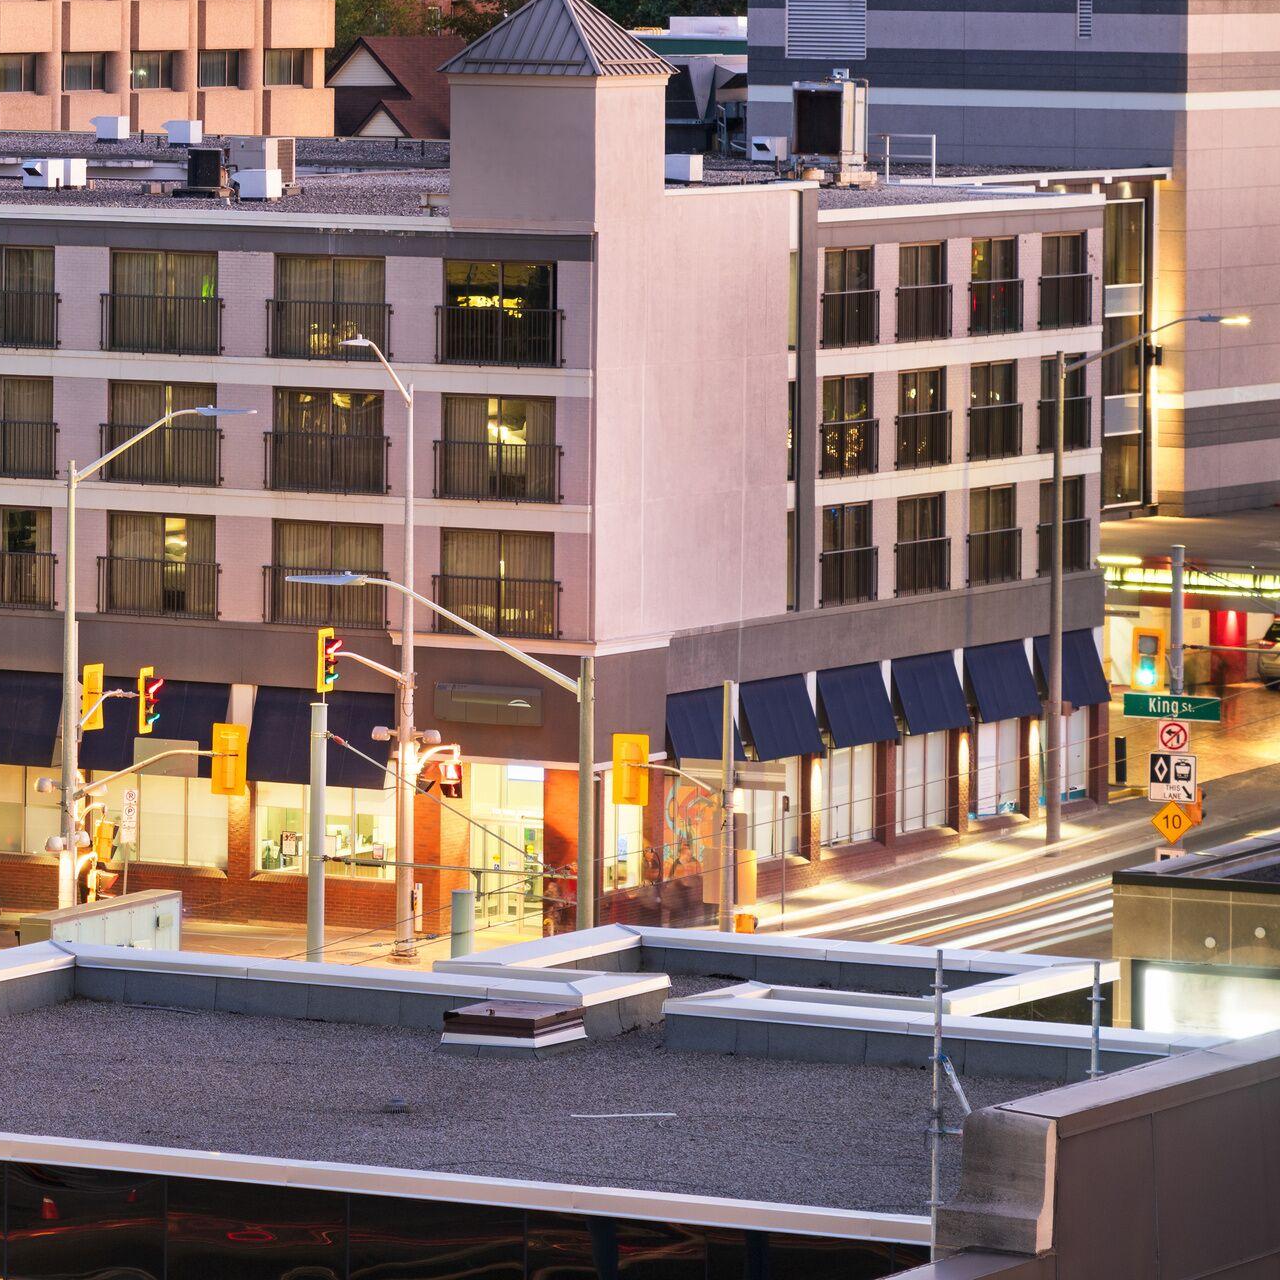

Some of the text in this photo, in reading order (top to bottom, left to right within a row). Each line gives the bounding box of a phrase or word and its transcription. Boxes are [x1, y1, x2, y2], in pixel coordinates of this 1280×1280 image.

[1149, 697, 1195, 717] King St.
[1163, 814, 1182, 829] 10
